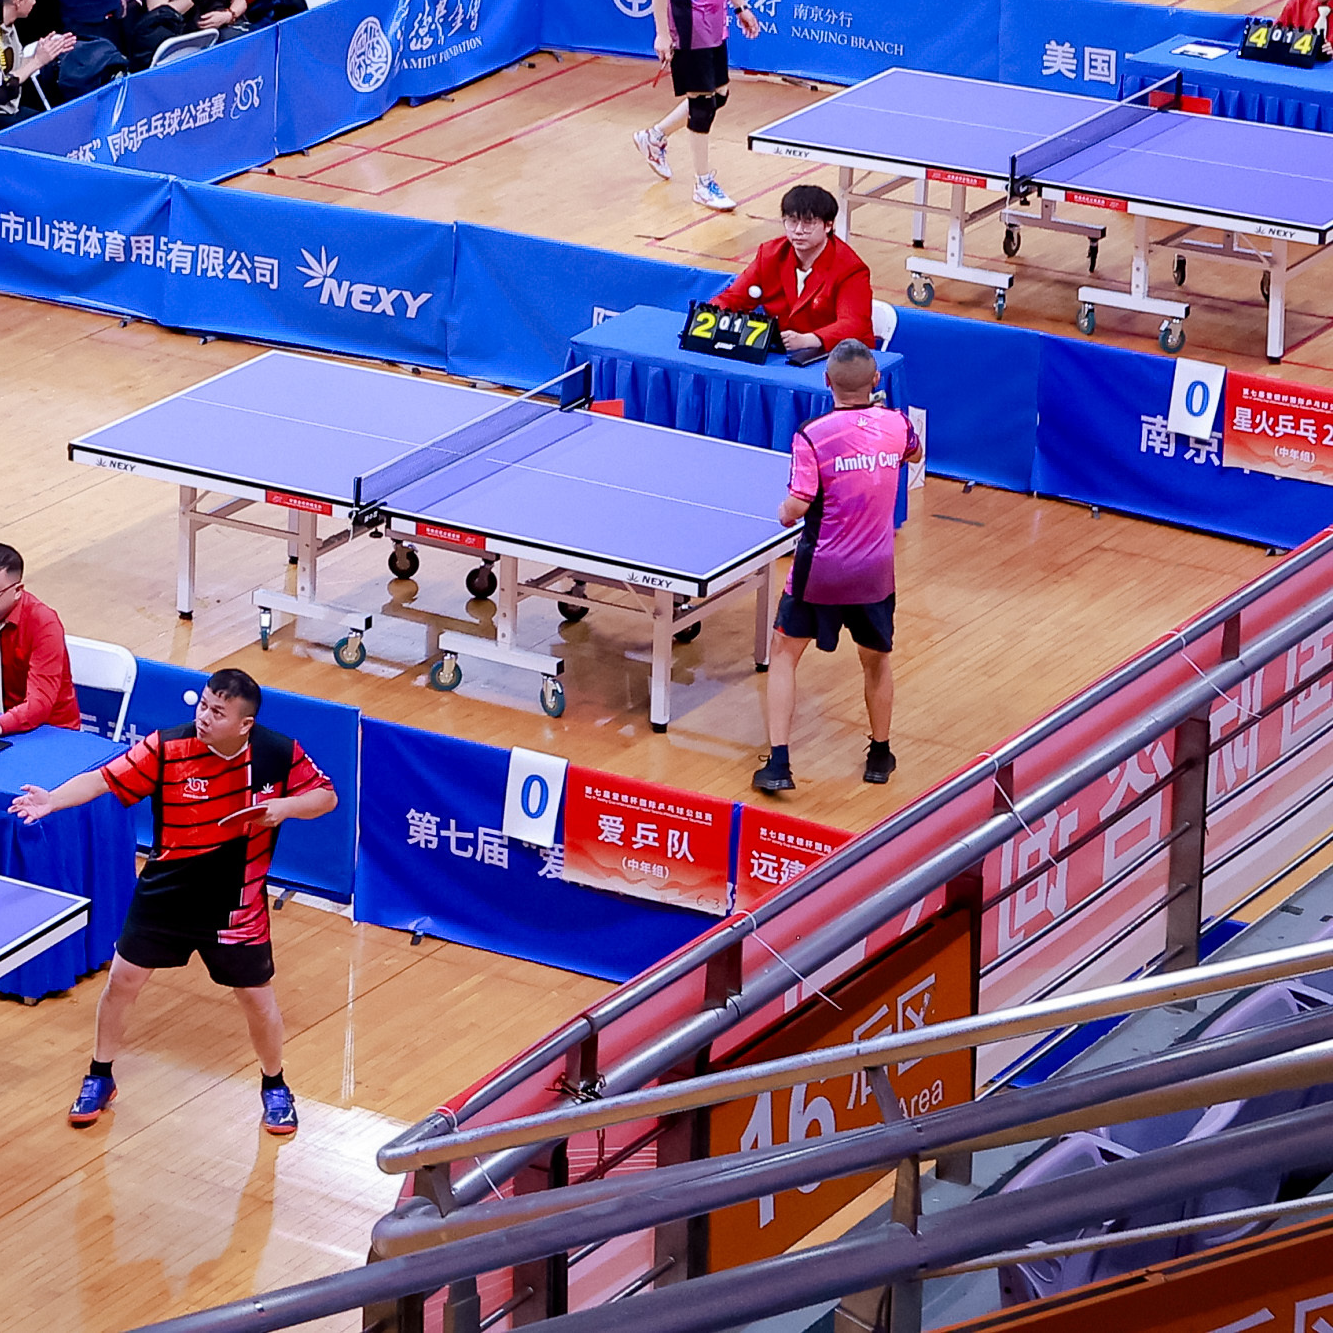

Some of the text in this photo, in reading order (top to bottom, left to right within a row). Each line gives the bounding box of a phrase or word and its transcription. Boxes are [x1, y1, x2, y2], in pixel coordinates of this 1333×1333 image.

[792, 28, 904, 56] NANJING BRANCH
[1249, 28, 1314, 55] 4 4
[785, 147, 810, 158] NEXY
[1267, 227, 1295, 238] NEXY
[322, 278, 431, 319] NEXY
[691, 311, 715, 338] 2
[744, 320, 766, 345] 7
[1186, 380, 1210, 417] 0
[108, 459, 135, 473] NEXY
[835, 450, 900, 473] Amity Cup
[641, 576, 673, 590] NEXY
[521, 775, 549, 819] 0
[598, 814, 695, 863] 爱乒队
[621, 856, 670, 880] (中年组)
